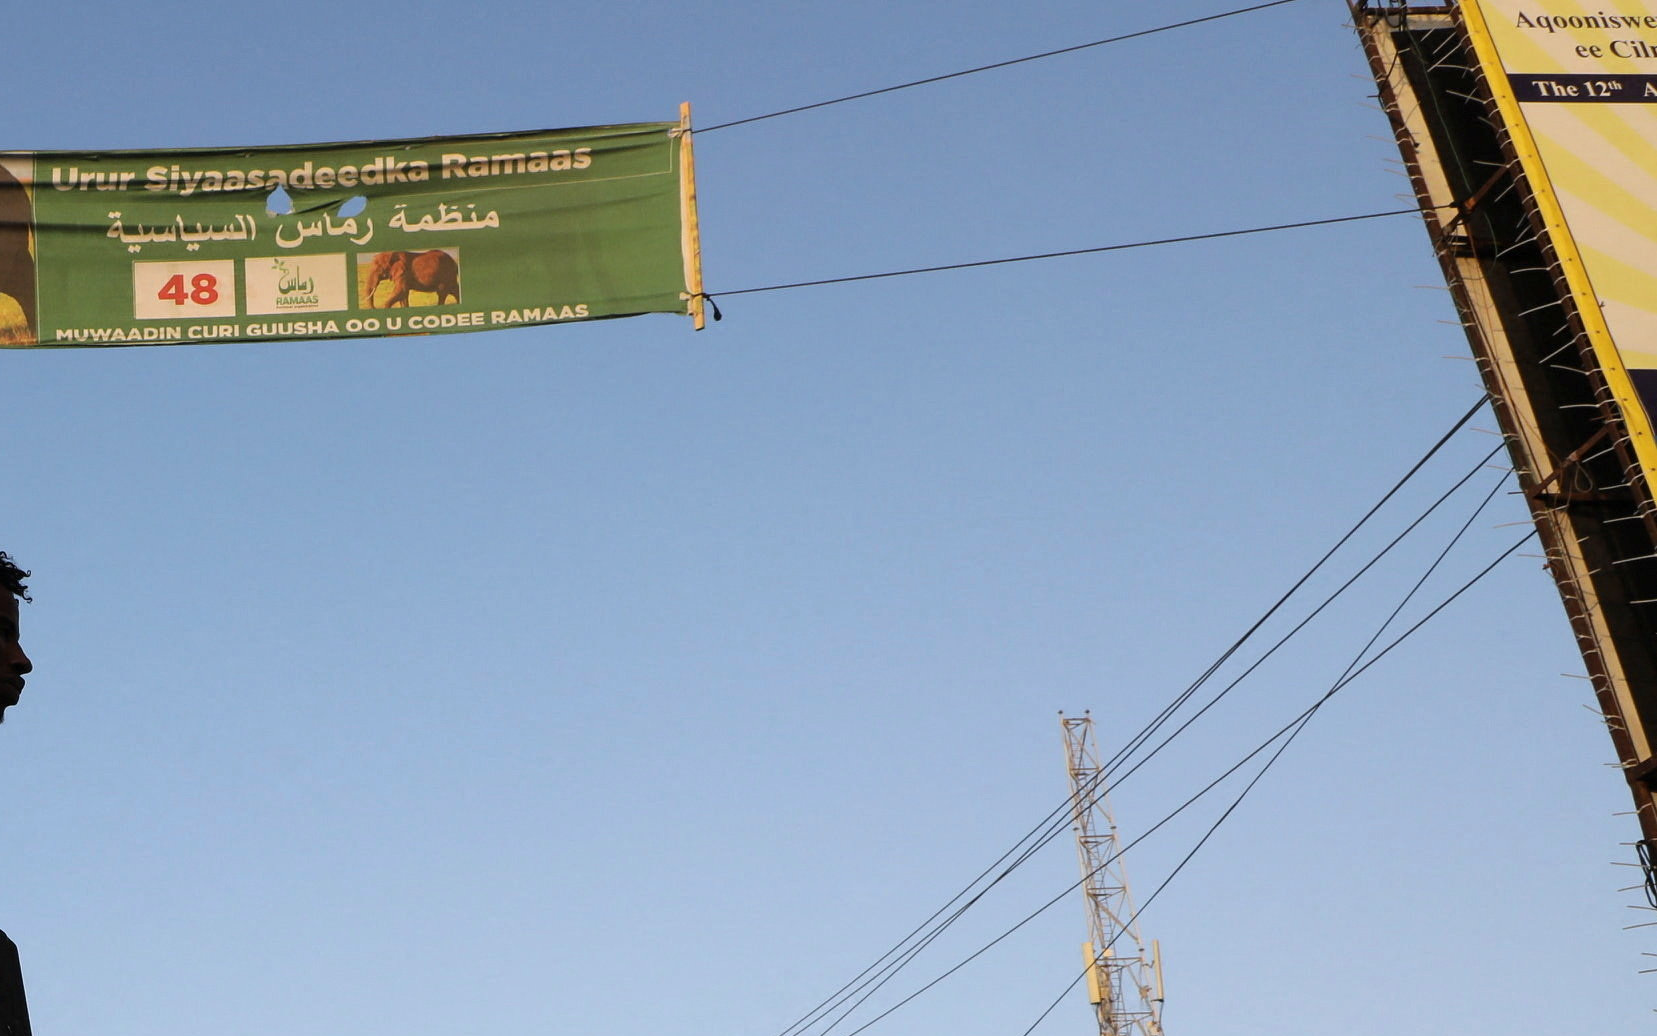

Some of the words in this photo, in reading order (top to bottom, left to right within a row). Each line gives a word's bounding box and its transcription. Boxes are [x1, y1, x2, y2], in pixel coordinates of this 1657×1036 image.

[1516, 11, 1657, 34] Aqooniswe
[1575, 44, 1603, 58] ee
[1531, 80, 1580, 97] The
[1584, 79, 1623, 97] 12th
[52, 166, 136, 192] Urur
[144, 156, 430, 196] Siyaasadeedka
[441, 146, 593, 180] Ramaas
[106, 210, 257, 253] السياسية
[275, 211, 375, 248] رماس
[389, 202, 500, 233] منظمة
[157, 273, 219, 306] 48
[276, 295, 319, 306] RAMAAS
[55, 326, 182, 342] MUWAADIN
[187, 324, 240, 339] CURI
[246, 319, 340, 337] GUUSHA
[345, 318, 381, 333] OO
[386, 316, 402, 330] U
[408, 311, 485, 329] CODEE
[491, 303, 590, 325] RAMAAS
